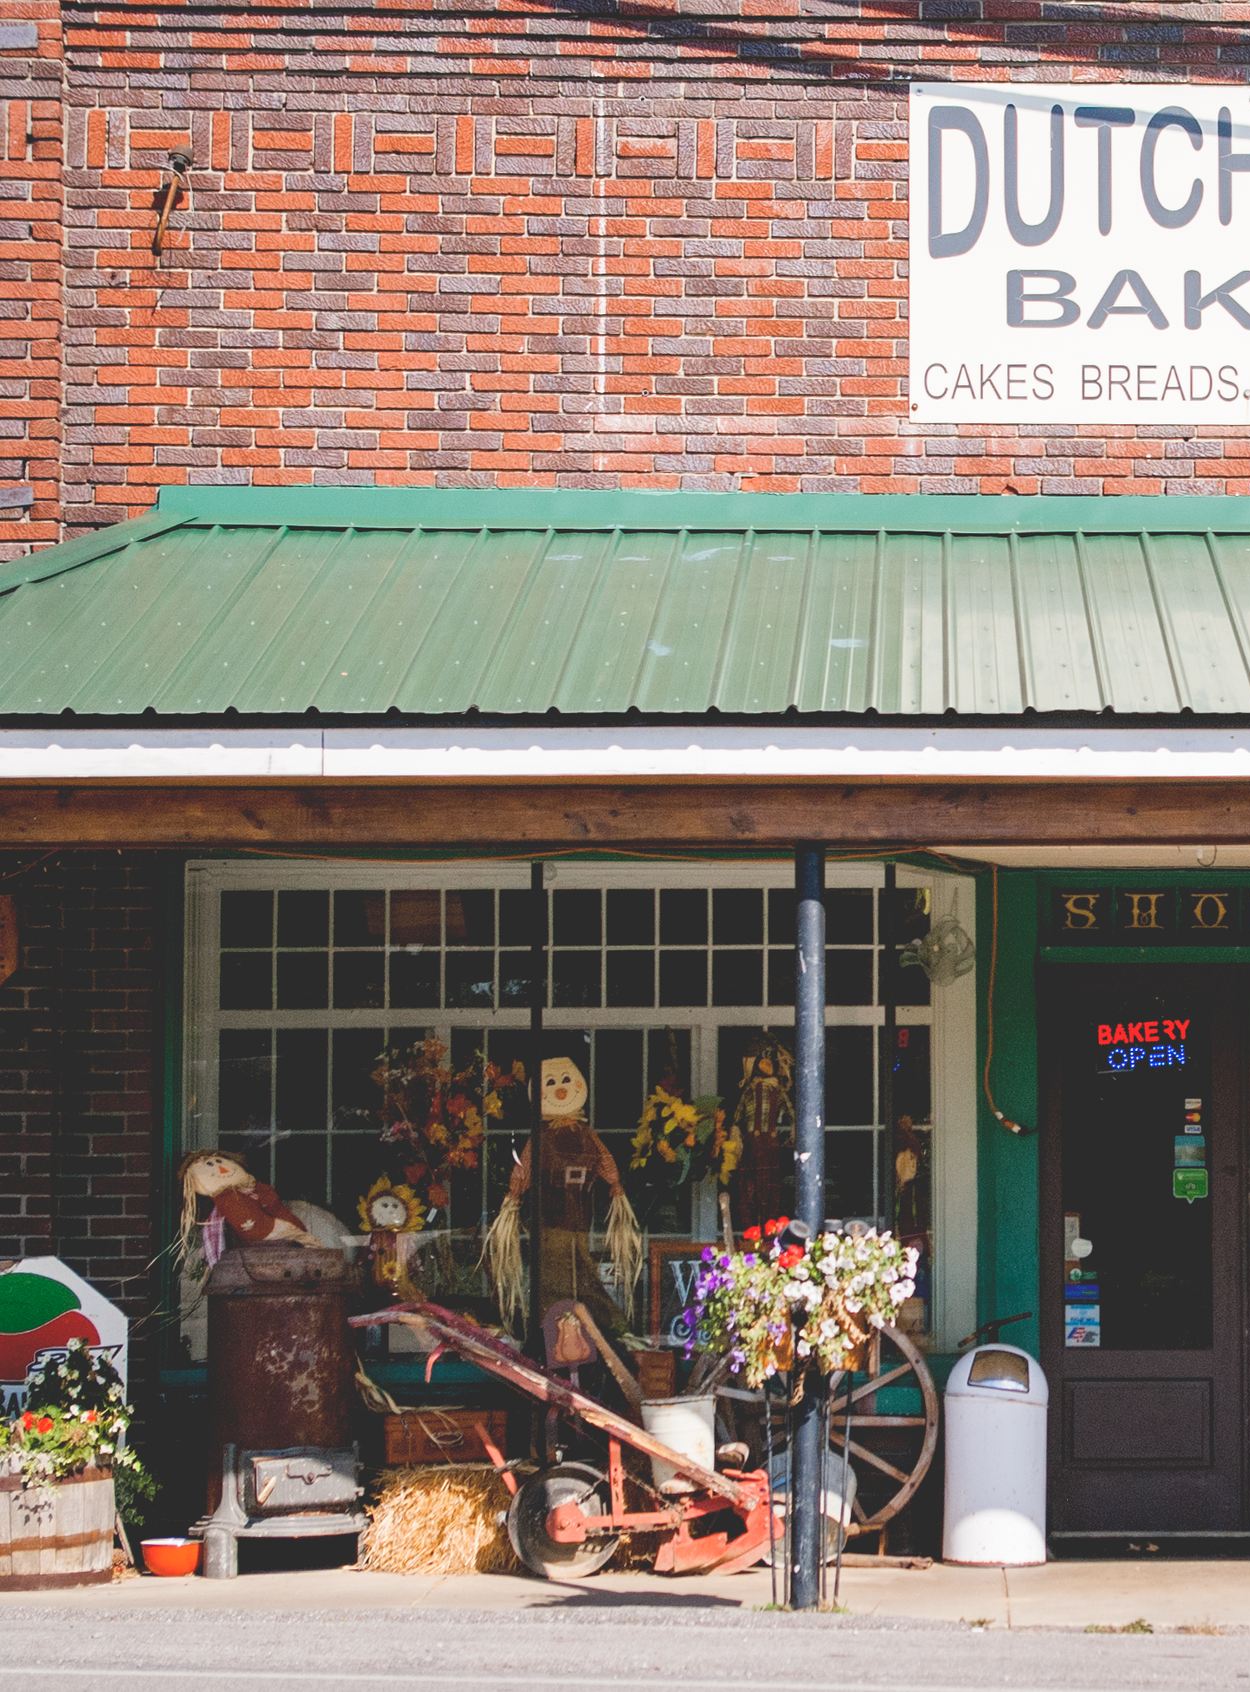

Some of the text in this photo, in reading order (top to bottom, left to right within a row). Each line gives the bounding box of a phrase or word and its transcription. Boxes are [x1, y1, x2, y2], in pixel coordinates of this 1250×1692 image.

[924, 363, 1055, 401] CAKES
[1081, 364, 1239, 402] BREADS
[1098, 1019, 1190, 1045] BAKERY
[1108, 1045, 1185, 1069] OPEN
